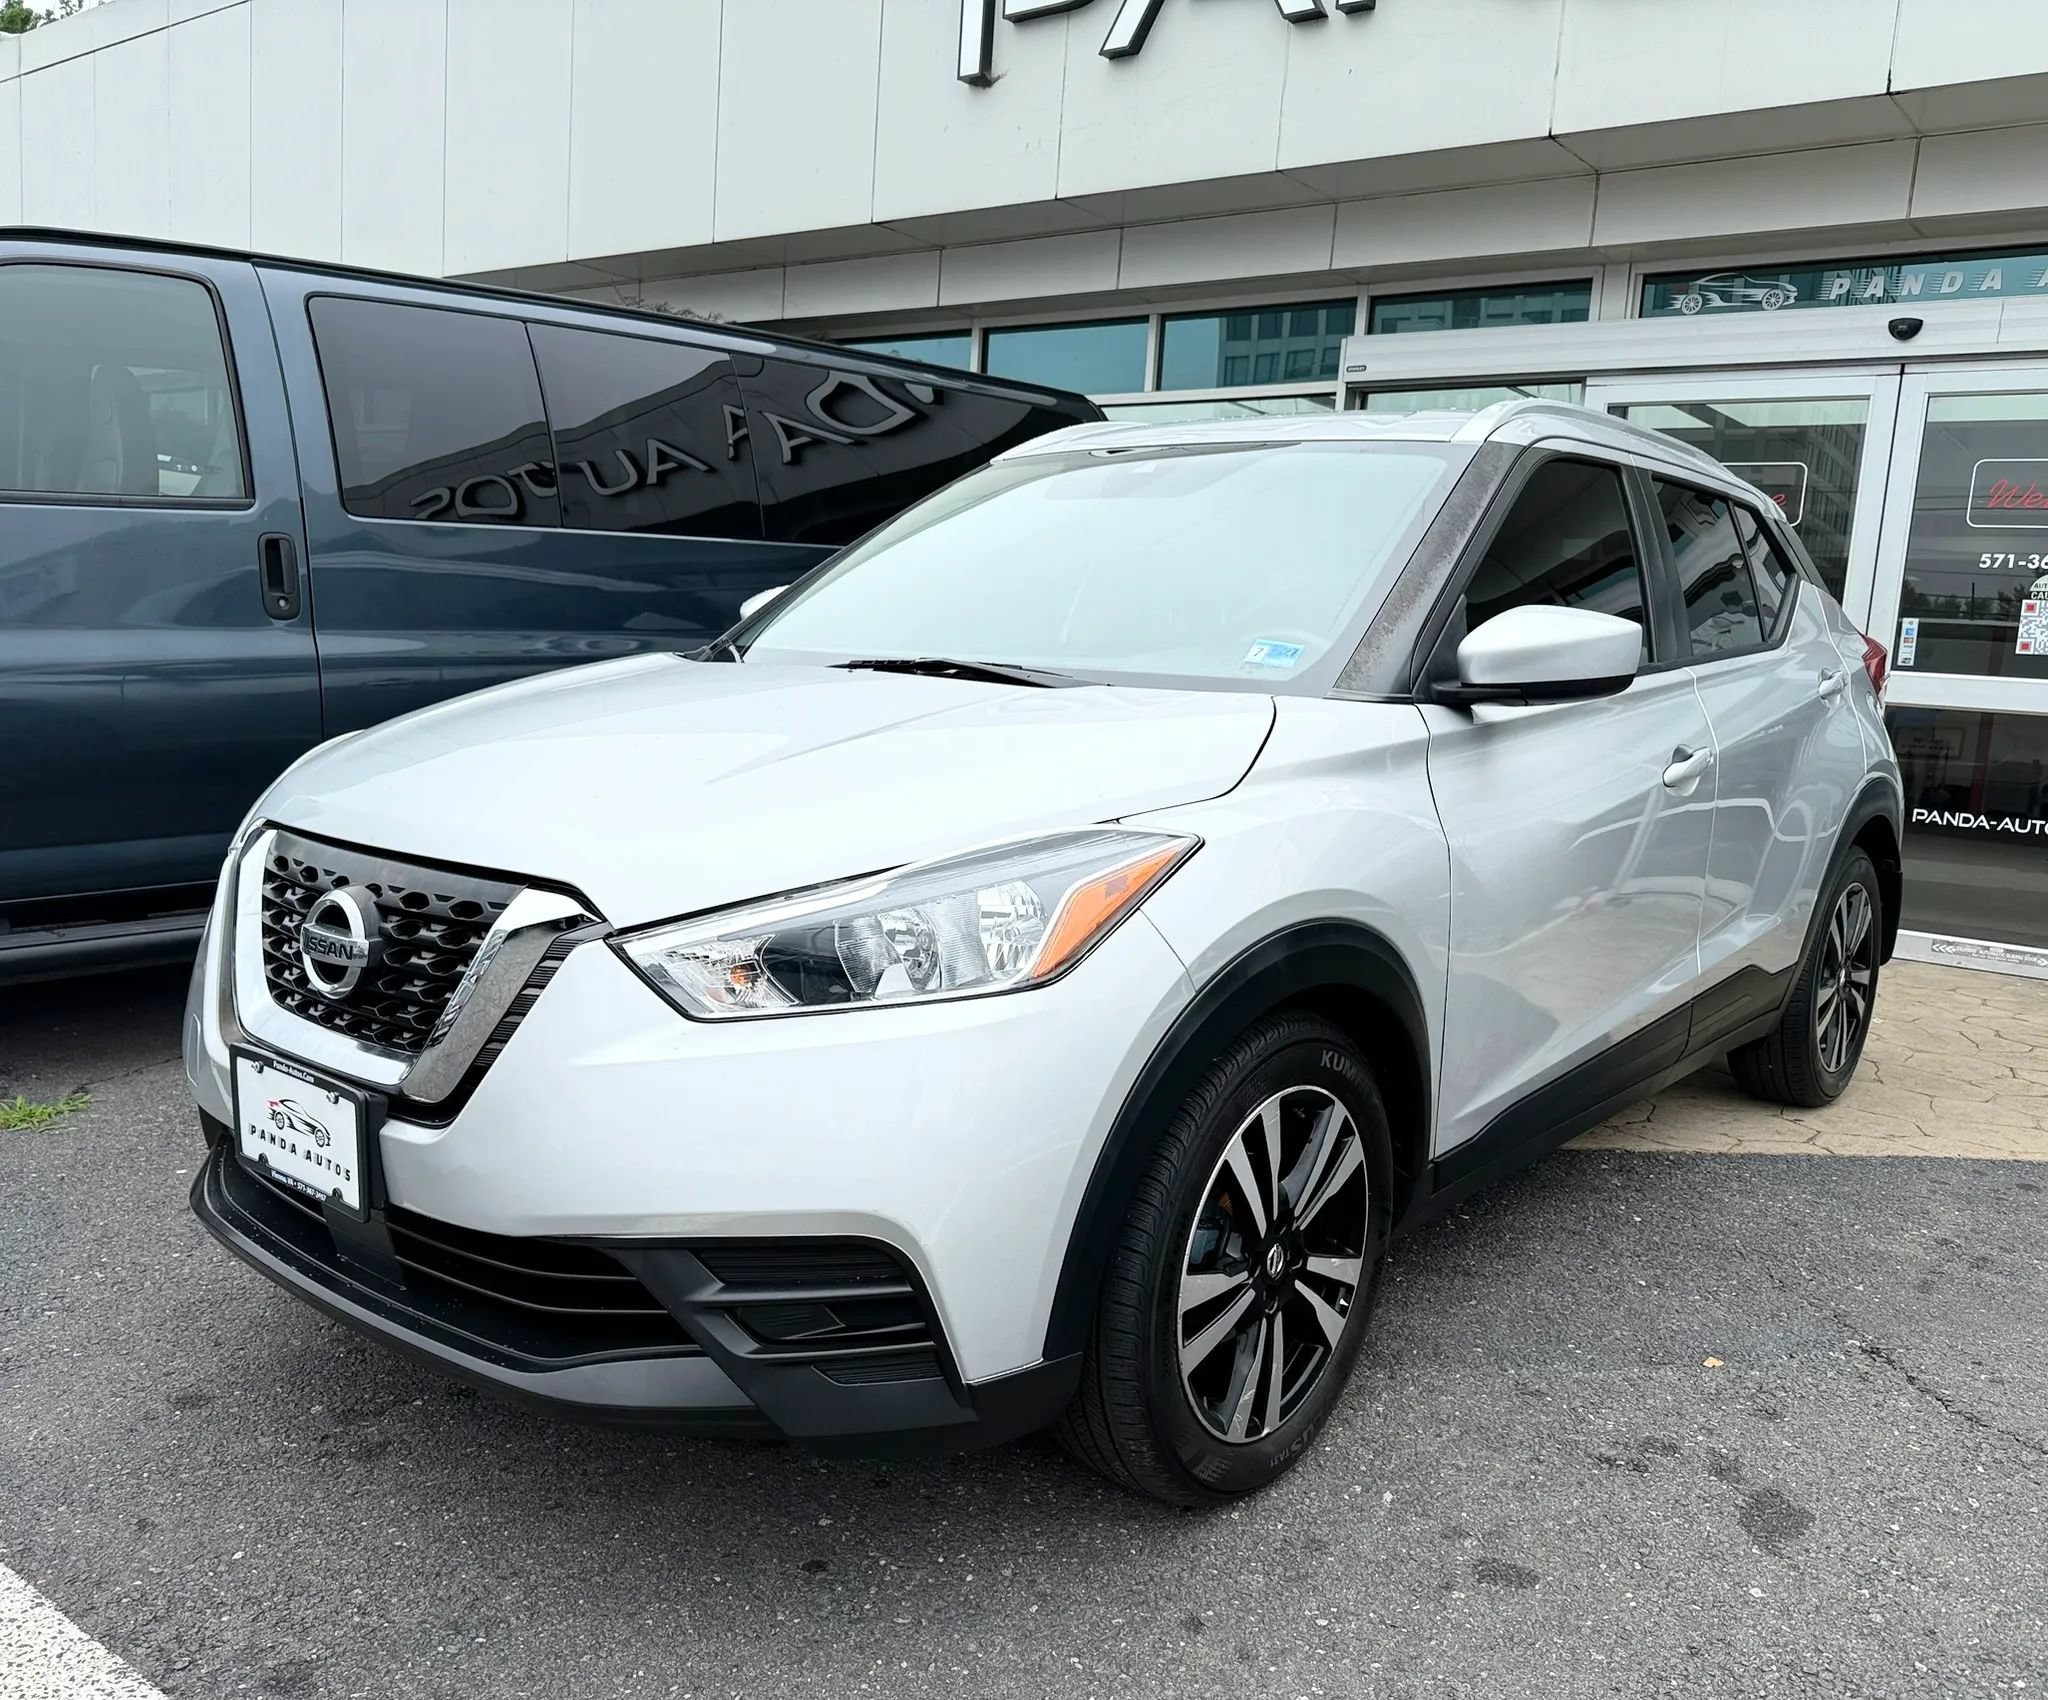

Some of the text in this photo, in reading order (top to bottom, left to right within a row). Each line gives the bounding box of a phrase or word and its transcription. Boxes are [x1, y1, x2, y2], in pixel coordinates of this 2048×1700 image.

[1818, 268, 2001, 300] PANDA
[303, 927, 353, 961] NISSAN
[248, 1123, 351, 1181] PANDA AUTOS
